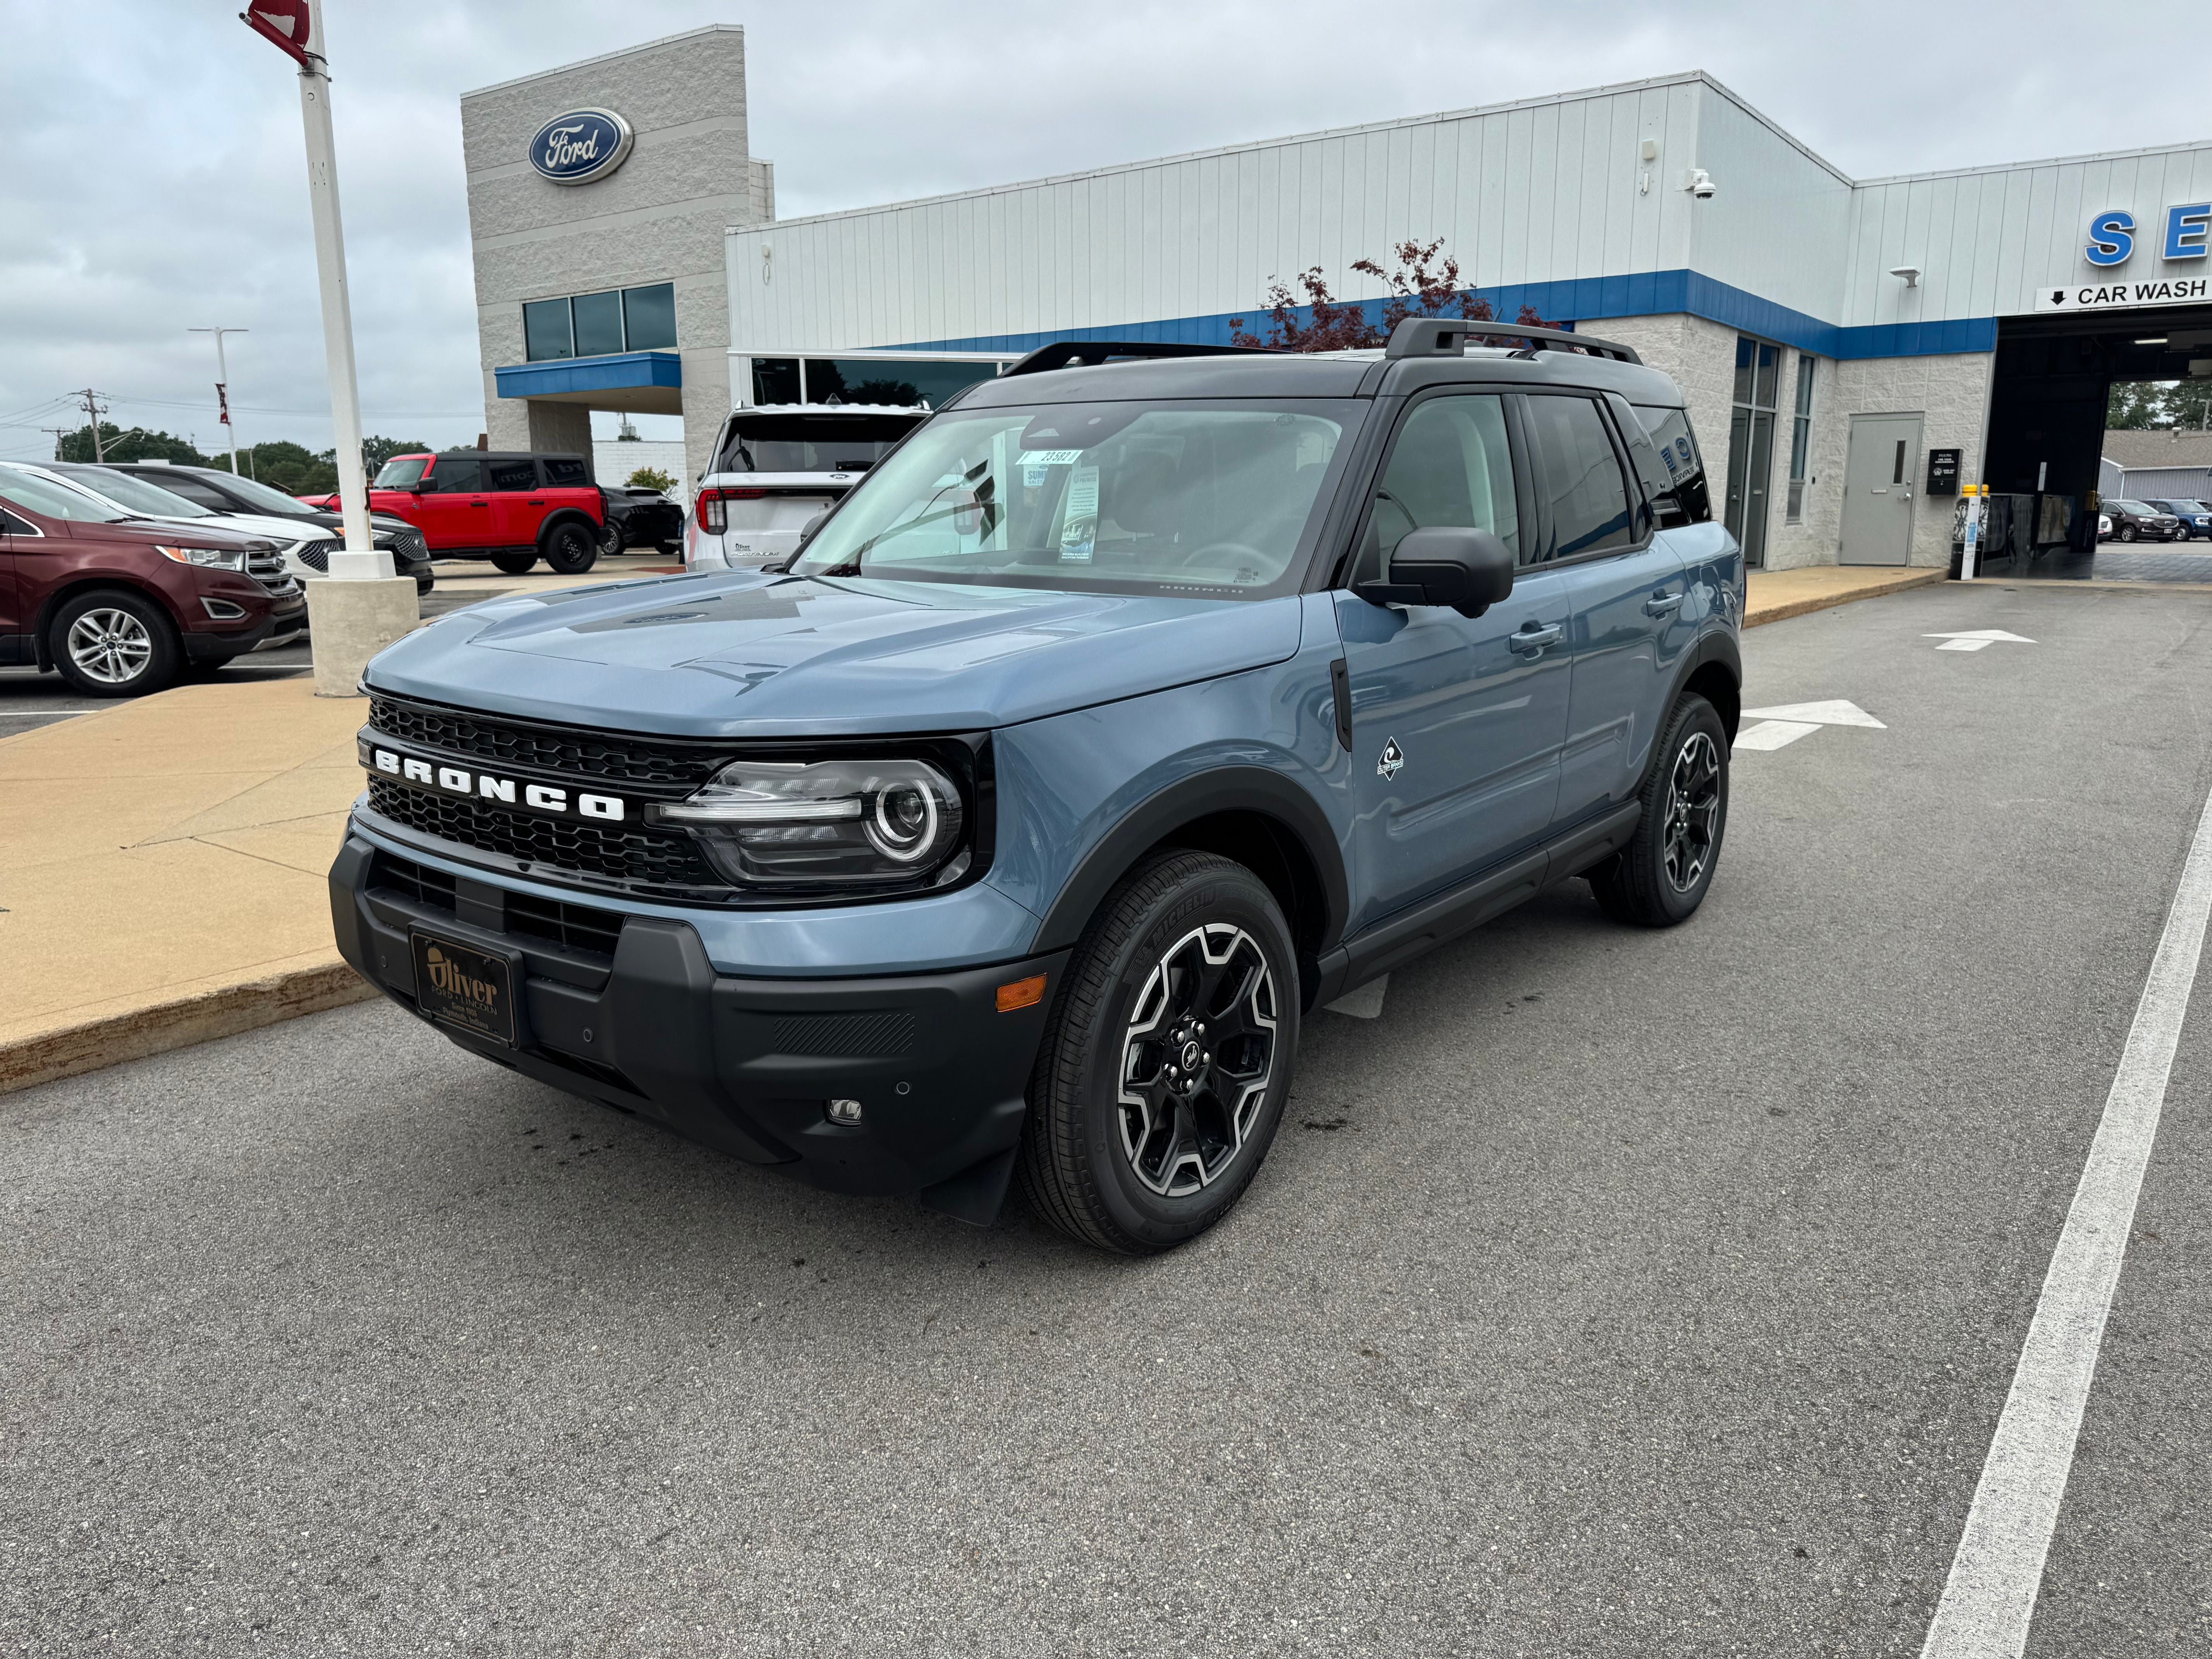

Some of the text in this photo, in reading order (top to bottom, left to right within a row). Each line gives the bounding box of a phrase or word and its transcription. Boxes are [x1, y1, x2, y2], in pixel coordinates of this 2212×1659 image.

[545, 124, 598, 168] Ford
[2078, 280, 2206, 304] CAR WASH
[1041, 452, 1071, 461] 23582
[376, 749, 625, 821] BRONCO
[1152, 887, 1216, 947] MICHELIN
[427, 946, 497, 1006] Oliver
[432, 985, 497, 1015] FORD LINCOLN
